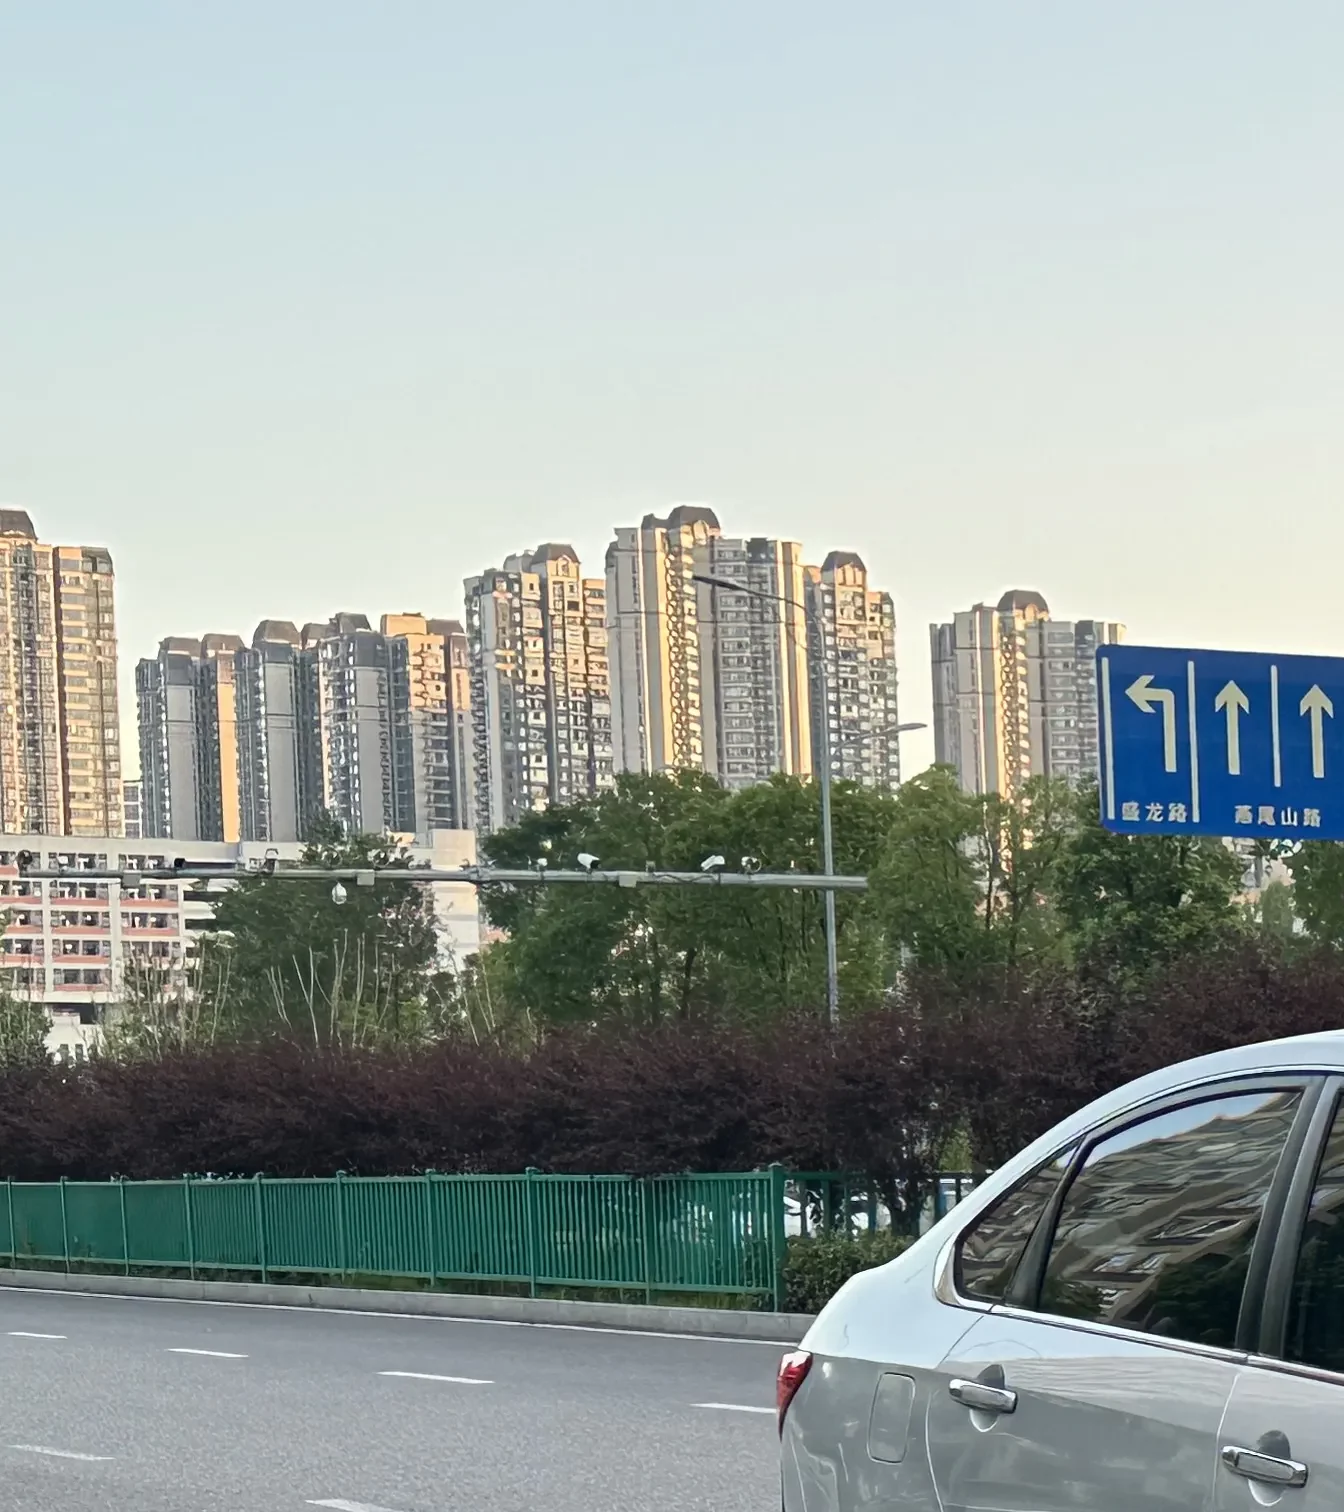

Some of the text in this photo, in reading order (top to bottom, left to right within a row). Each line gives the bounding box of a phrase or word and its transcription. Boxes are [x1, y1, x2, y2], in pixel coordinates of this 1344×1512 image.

[1121, 800, 1187, 823] 盛龙路
[1234, 804, 1321, 828] 燕尾山路
